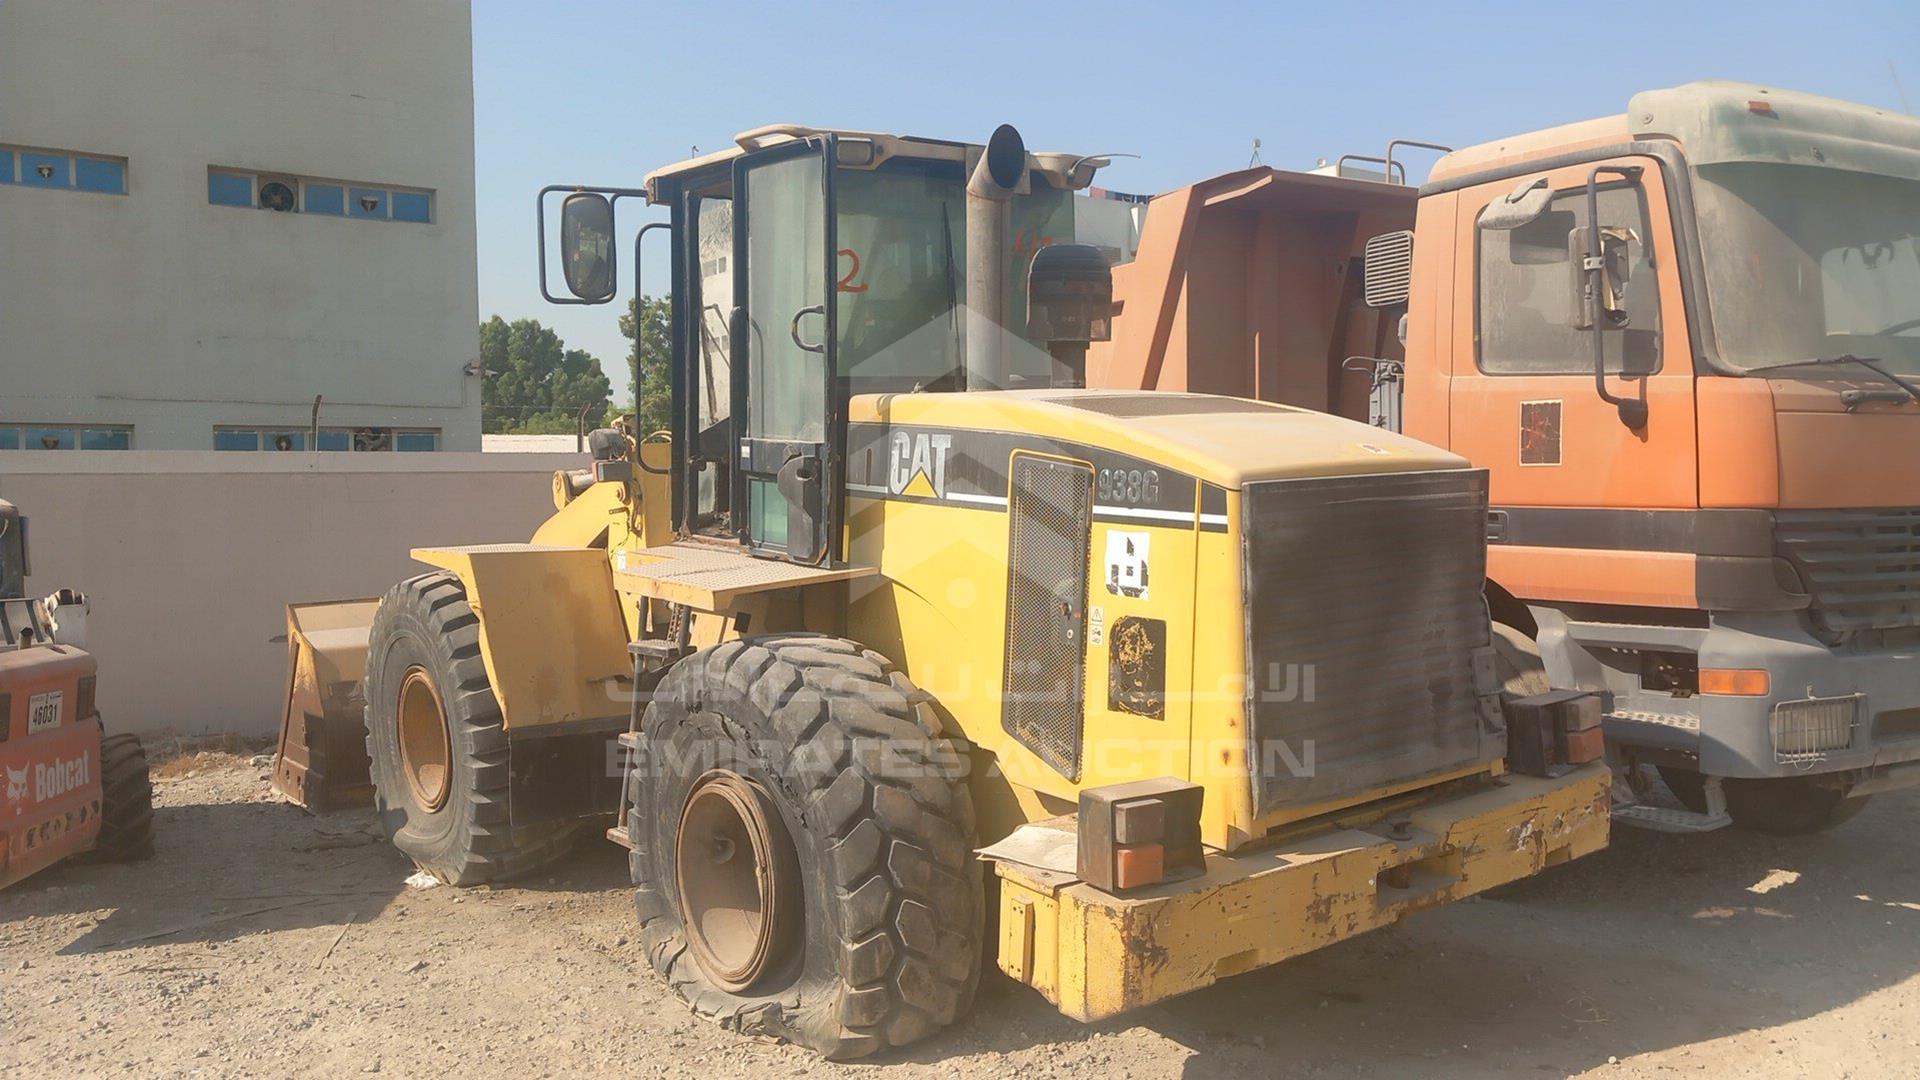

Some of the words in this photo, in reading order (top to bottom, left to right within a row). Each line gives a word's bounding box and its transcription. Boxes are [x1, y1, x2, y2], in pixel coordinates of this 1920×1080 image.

[889, 431, 952, 499] CAT
[1098, 468, 1160, 504] 938G
[33, 704, 58, 727] 46031
[35, 750, 90, 803] Bobcat
